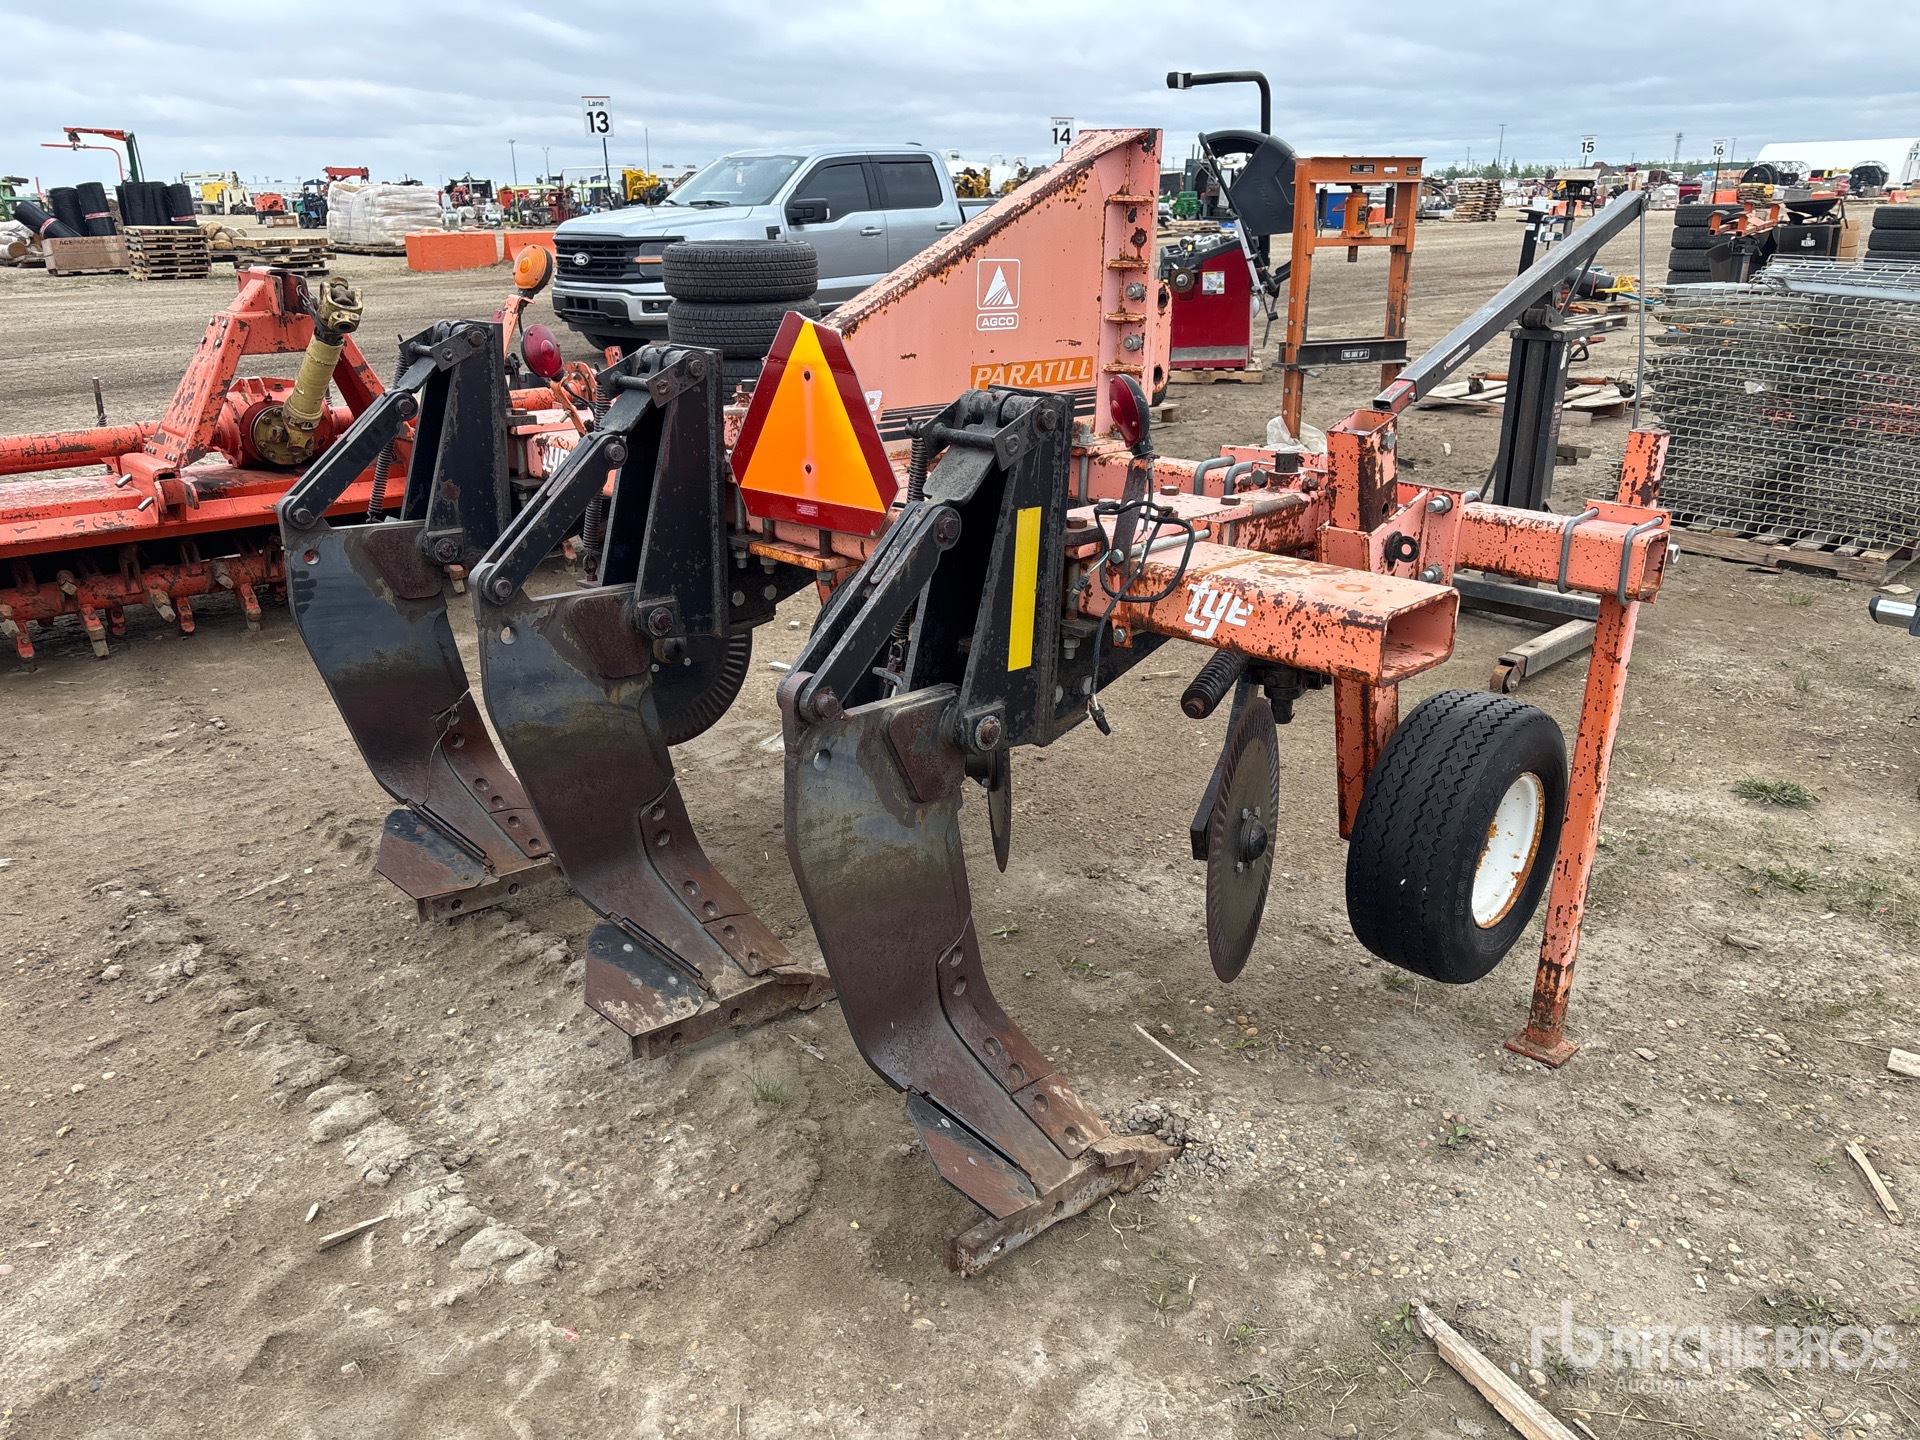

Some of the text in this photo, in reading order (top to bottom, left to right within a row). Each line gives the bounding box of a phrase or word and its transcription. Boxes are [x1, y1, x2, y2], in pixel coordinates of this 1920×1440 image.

[586, 111, 610, 133] 13
[1052, 128, 1071, 145] 14
[1581, 142, 1595, 153] 15
[1713, 146, 1724, 155] 16
[981, 316, 1015, 327] AGCO
[973, 359, 1091, 389] PARATILL
[1184, 580, 1254, 639] tye
